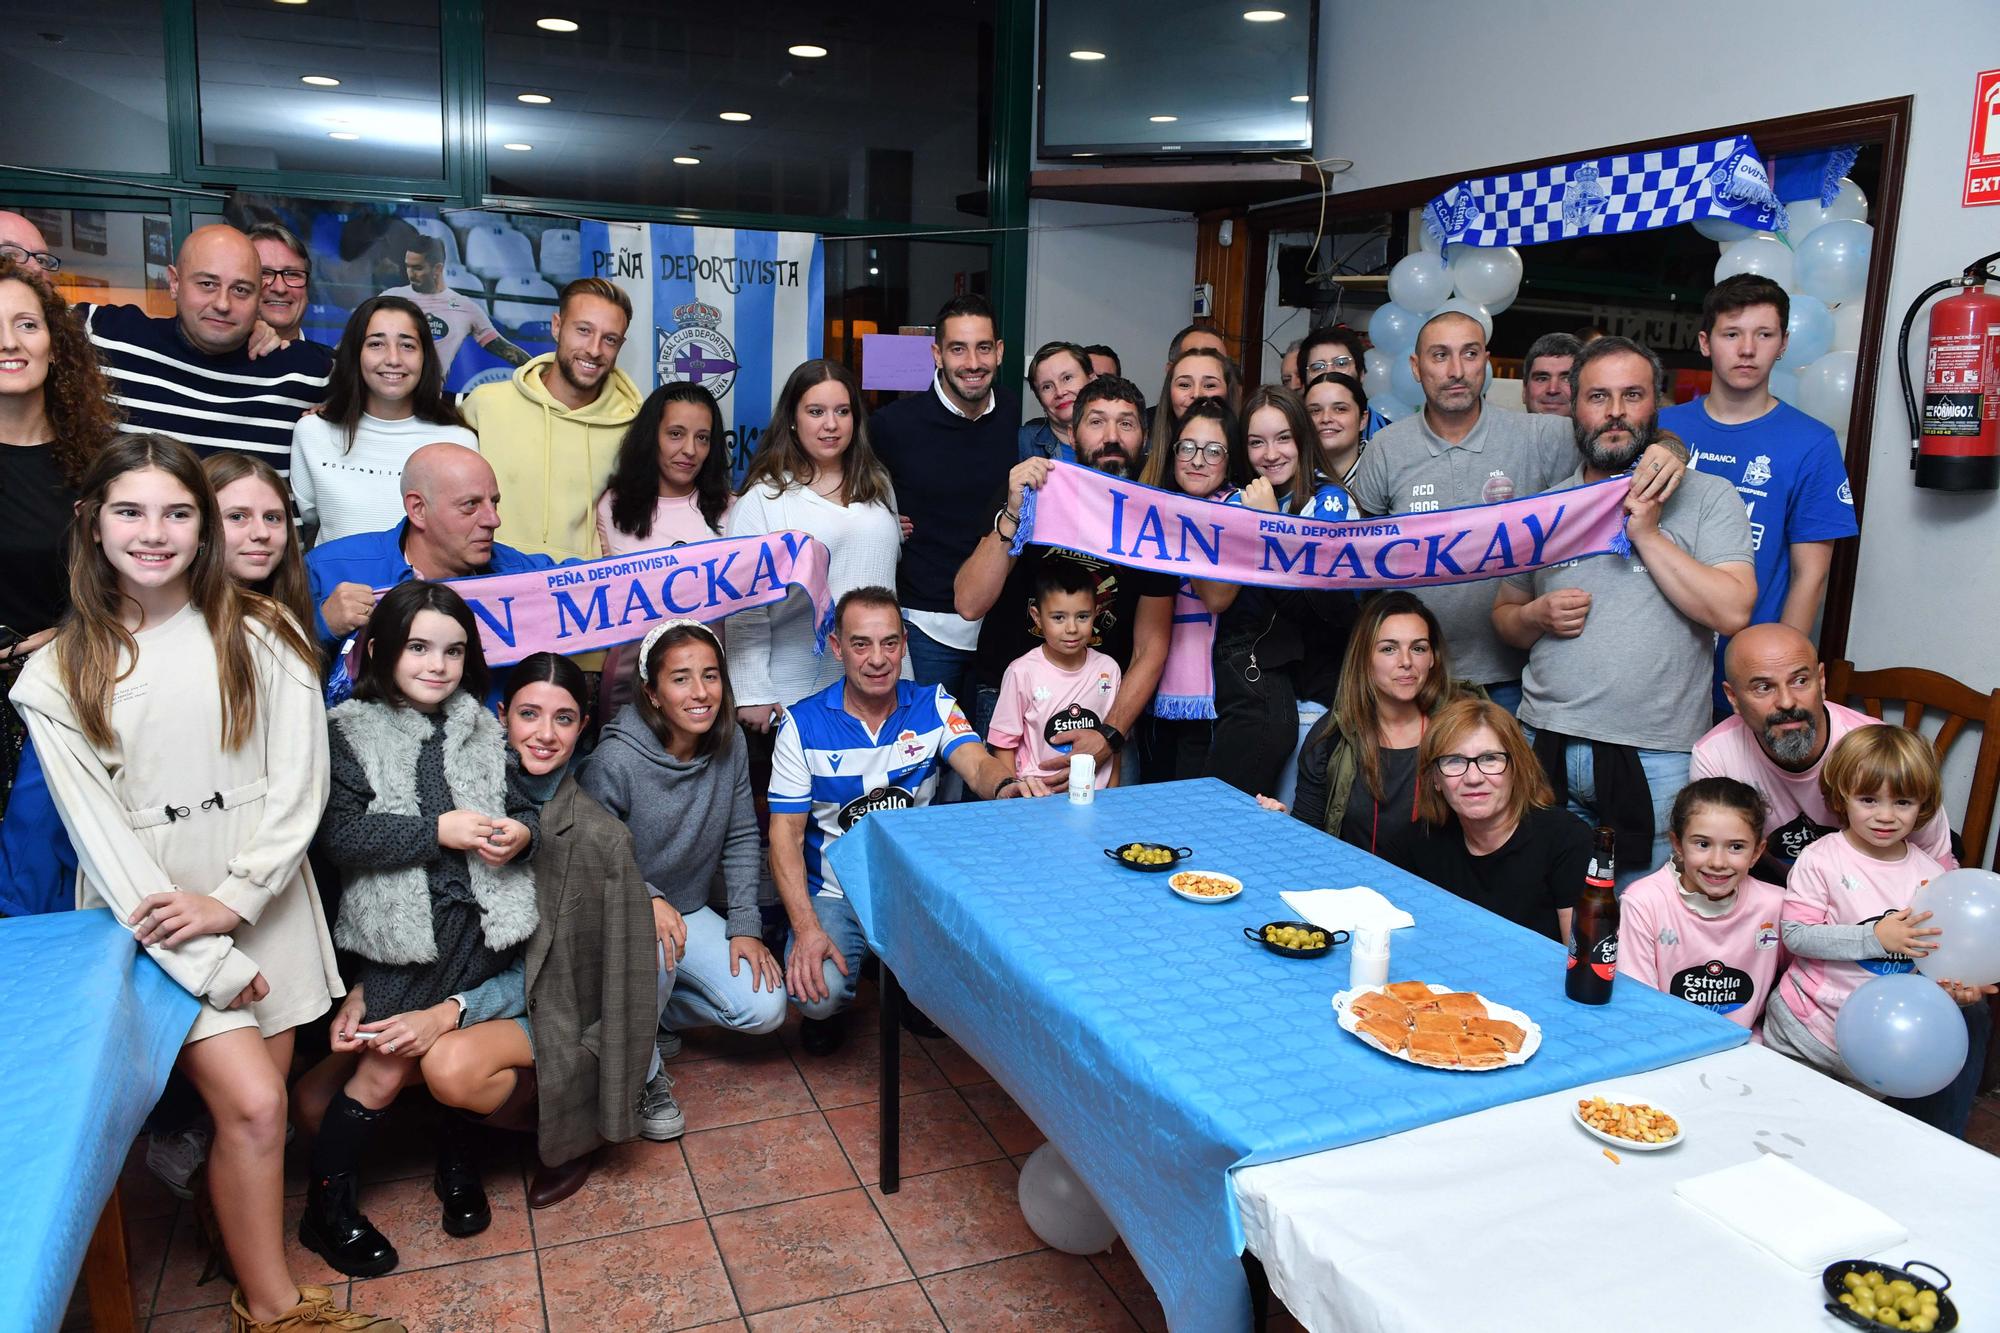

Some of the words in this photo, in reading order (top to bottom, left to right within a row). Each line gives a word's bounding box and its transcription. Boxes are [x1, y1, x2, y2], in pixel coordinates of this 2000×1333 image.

[1969, 175, 2000, 193] EXT
[592, 247, 645, 280] PEÑA
[660, 253, 800, 295] DEPORTIVISTA
[662, 342, 677, 361] REAL
[673, 329, 694, 344] CLUB
[695, 329, 732, 358] DEPORTIVO
[1703, 452, 1736, 464] ABANCA
[1412, 484, 1435, 497] RCD
[1107, 488, 1224, 565] IAN
[1256, 504, 1566, 581] MACKAY
[1259, 516, 1297, 536] PEÑA
[1301, 523, 1400, 538] DEPORTIVISTA
[547, 571, 585, 589] PEÑA
[588, 554, 680, 580] DEPORTIVISTA
[464, 596, 516, 652] N
[551, 530, 811, 639] MACKAY
[1053, 717, 1094, 731] Estrella
[847, 795, 907, 818] Estrella
[1682, 973, 1741, 990] Estrella
[1684, 987, 1737, 1003] Galicia
